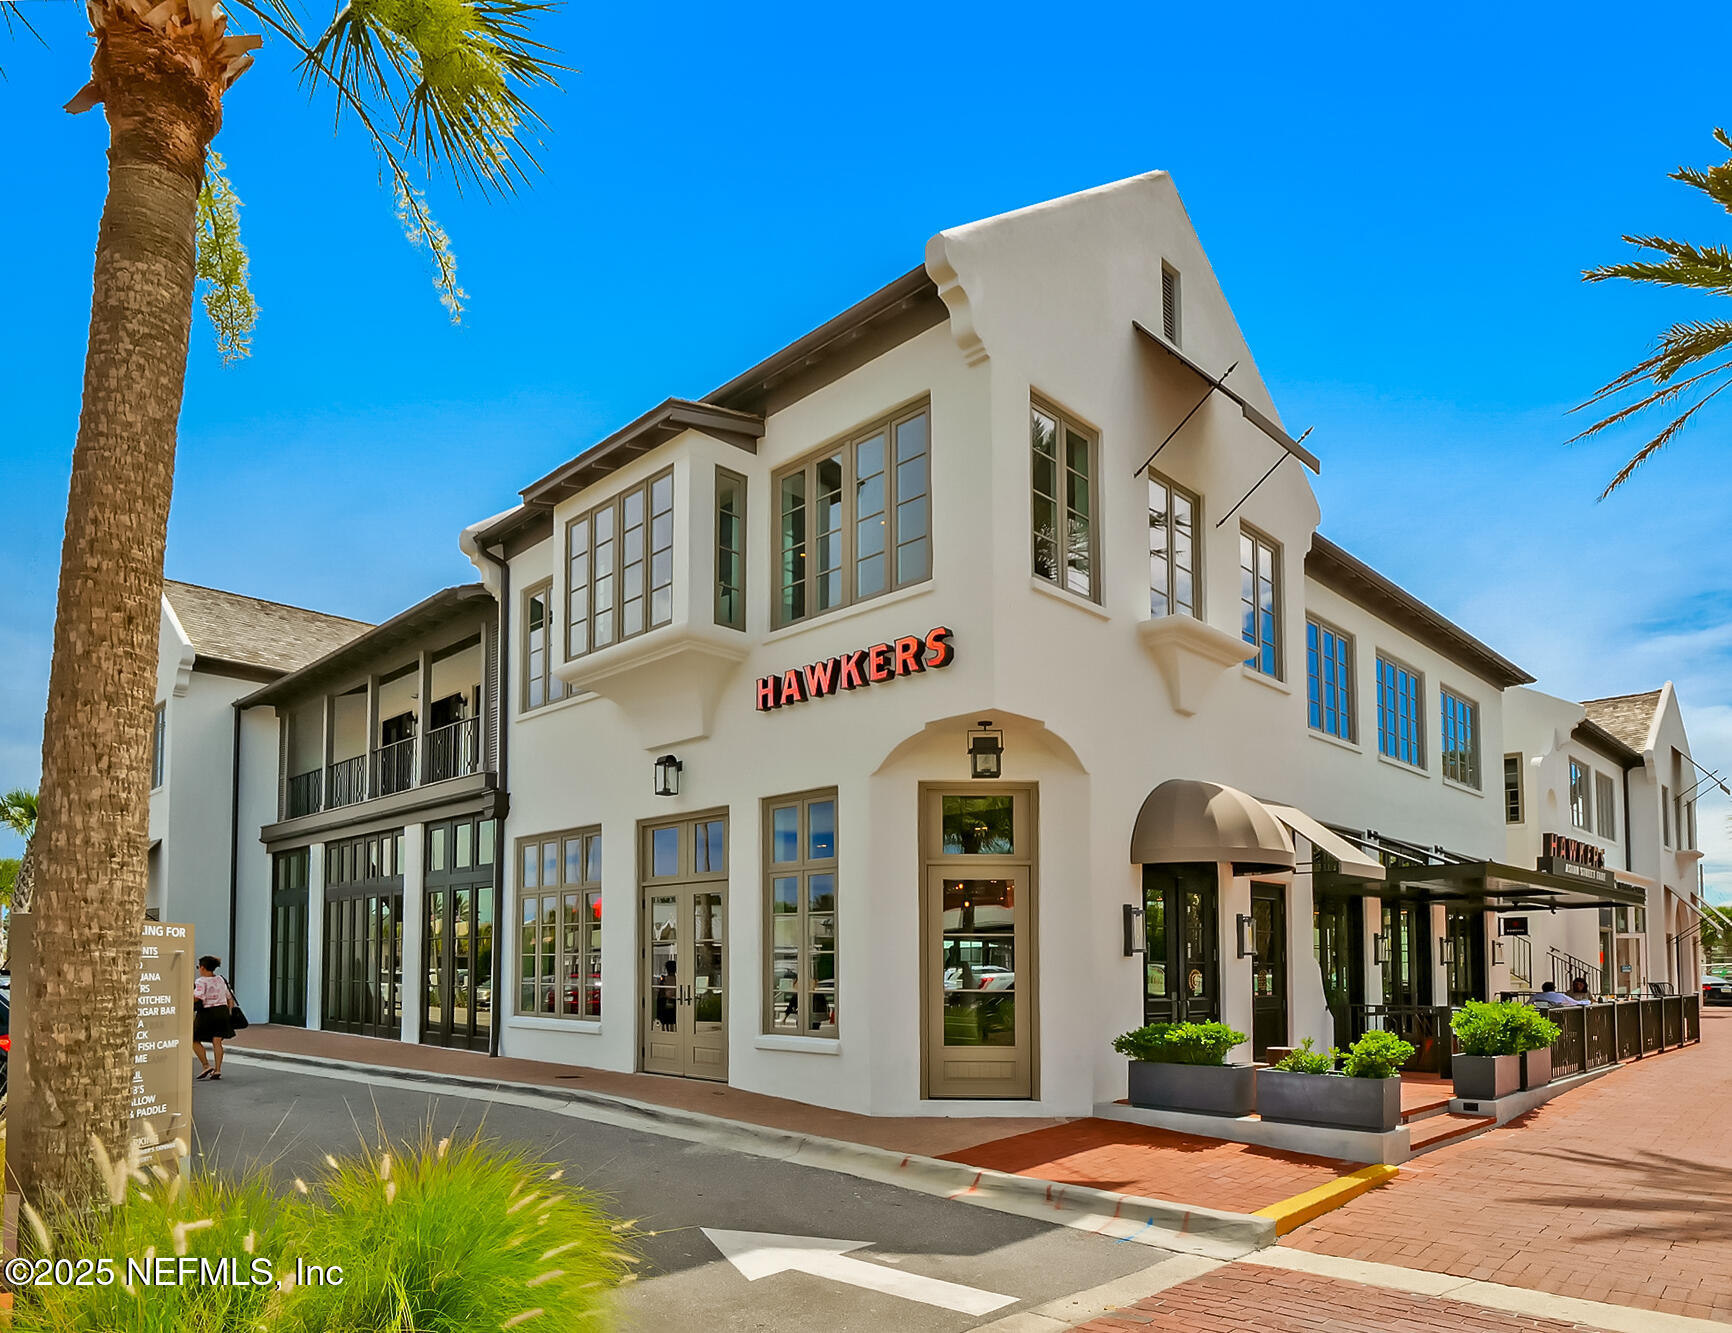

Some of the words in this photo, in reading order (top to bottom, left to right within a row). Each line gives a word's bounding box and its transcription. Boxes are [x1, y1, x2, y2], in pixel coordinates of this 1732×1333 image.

[756, 626, 955, 712] HAWKERS
[1543, 833, 1606, 870] HAWKERS
[166, 927, 186, 938] FOR
[137, 995, 171, 1005] KITCHEN
[160, 1006, 176, 1015] BAR
[138, 1042, 155, 1051] FISH
[156, 1039, 180, 1049] CAMP
[136, 1104, 168, 1118] PADDLE
